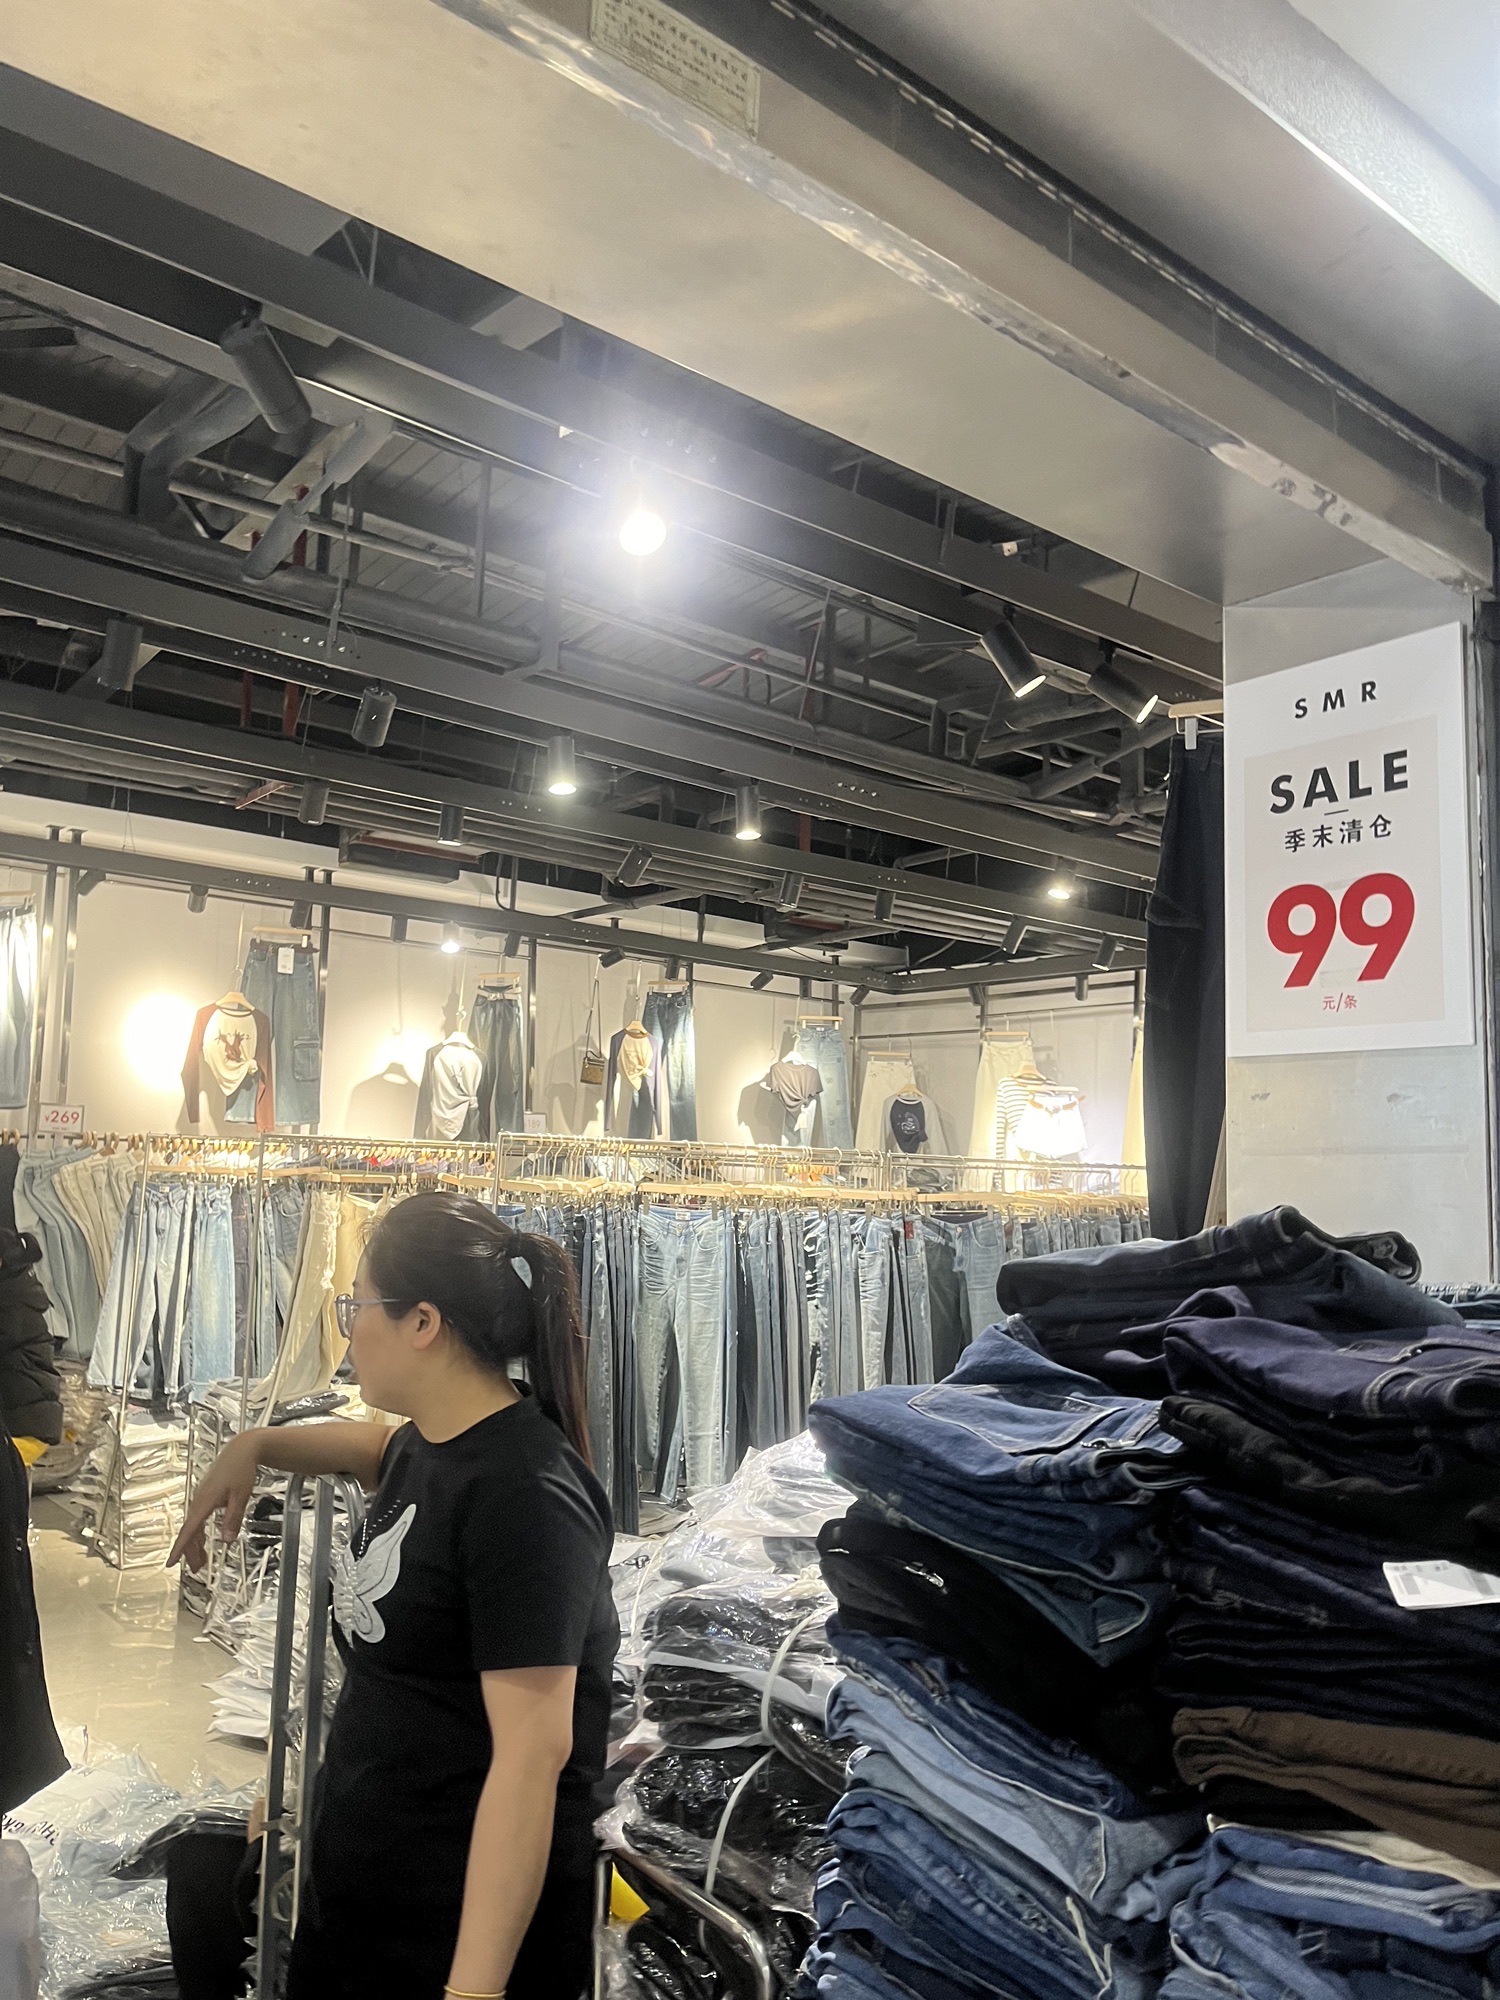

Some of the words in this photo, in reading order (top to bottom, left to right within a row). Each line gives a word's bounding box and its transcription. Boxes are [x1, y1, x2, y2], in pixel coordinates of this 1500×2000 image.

[1295, 680, 1378, 719] SMR
[1270, 749, 1409, 814] SALE
[1285, 814, 1393, 853] 季末清仓
[1267, 872, 1415, 989] 99
[1323, 992, 1357, 1013] 元/条
